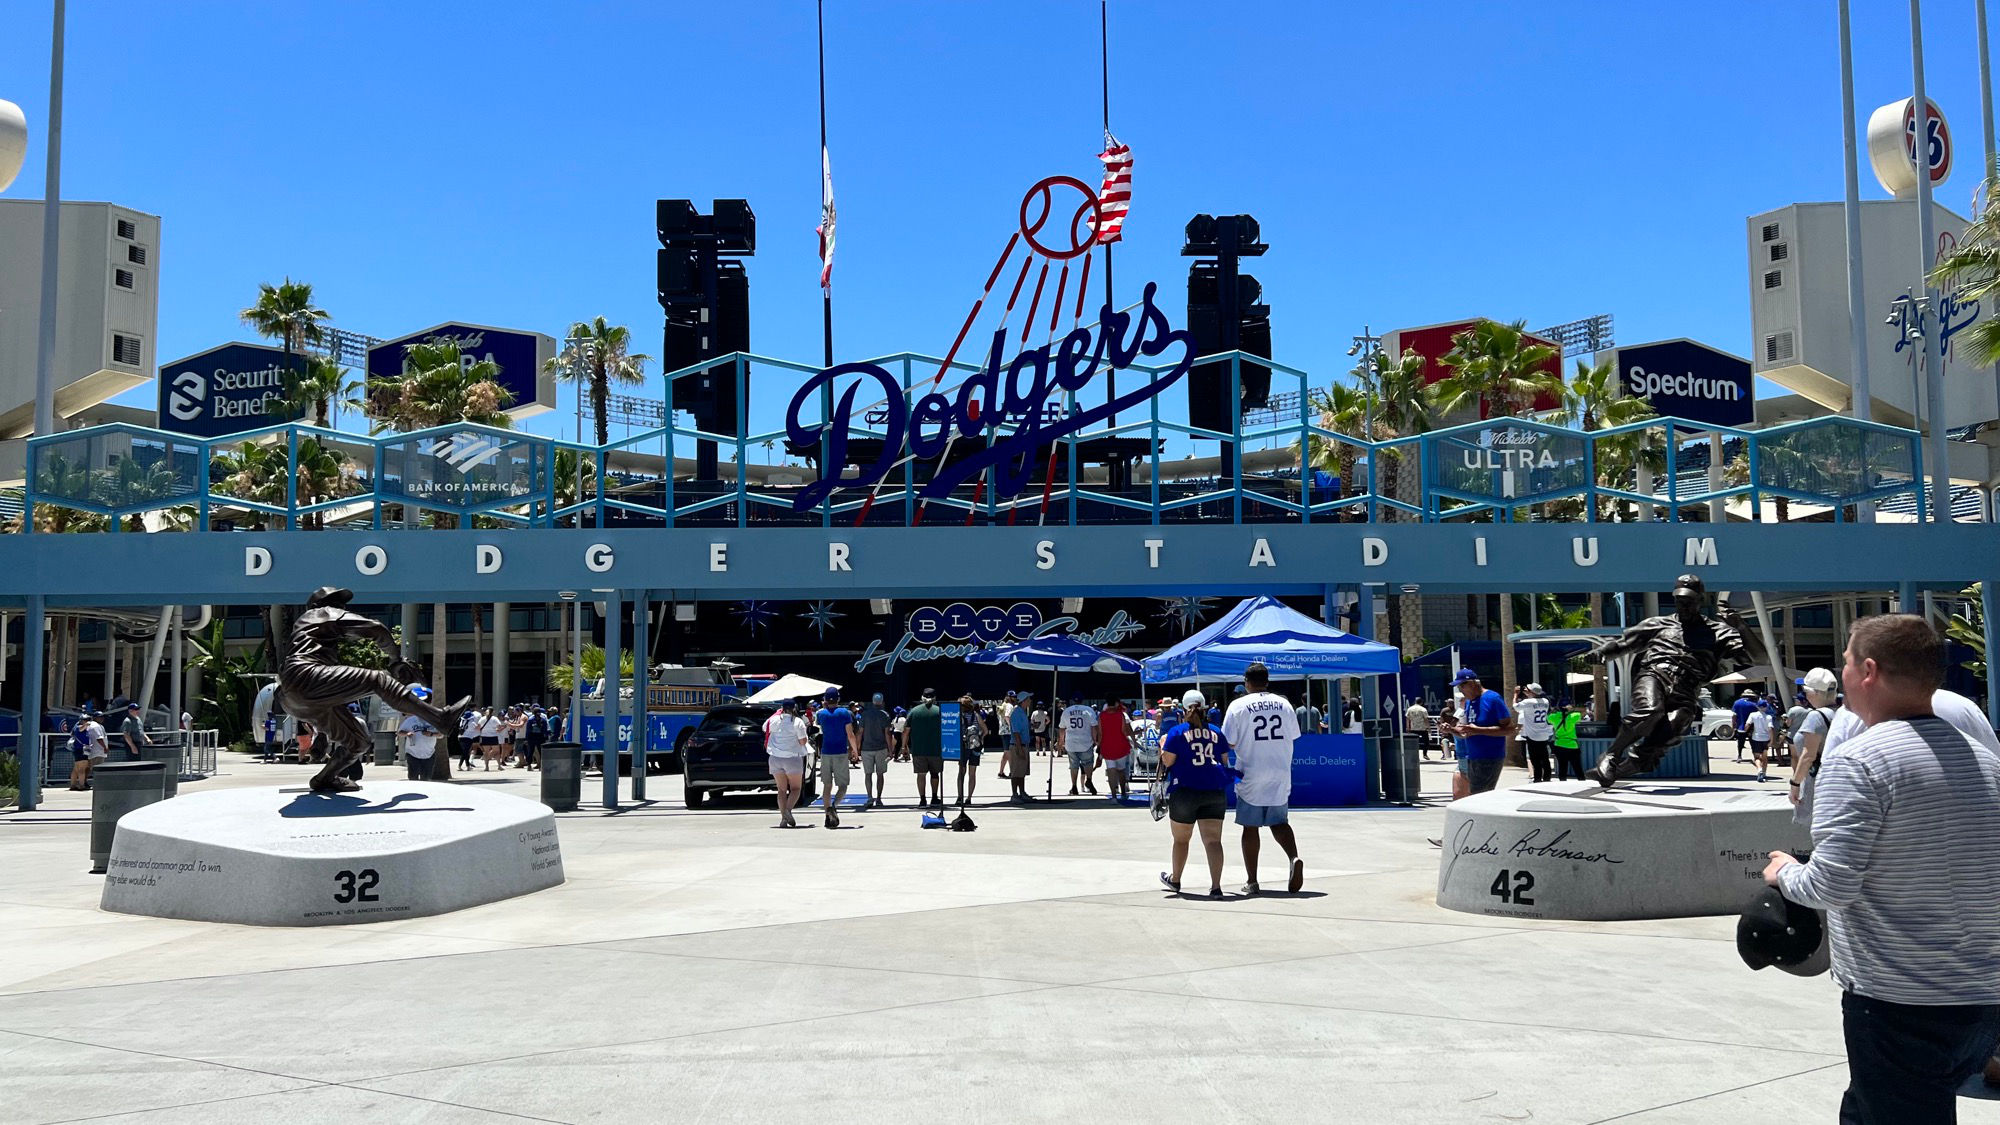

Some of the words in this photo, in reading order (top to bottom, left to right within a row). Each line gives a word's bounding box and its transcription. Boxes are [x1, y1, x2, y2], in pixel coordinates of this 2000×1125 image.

[1629, 366, 1739, 401] Spectrum
[786, 281, 1198, 512] Dodgers
[1475, 431, 1537, 446] Michelob
[1463, 449, 1553, 470] ULTRA
[408, 483, 441, 492] BANK
[444, 483, 460, 492] OF
[462, 483, 517, 492] AMERICA
[245, 543, 852, 576] DODGER
[1035, 537, 1720, 570] STADIUM
[919, 614, 1033, 632] BLUE
[854, 632, 978, 674] Heaven
[1246, 700, 1283, 714] KERSHAW
[1422, 685, 1441, 712] LA
[1069, 717, 1084, 729] 50
[1253, 714, 1284, 741] 22
[1534, 710, 1547, 724] 22
[587, 724, 597, 742] LA
[1183, 728, 1219, 744] WOOD
[1191, 743, 1218, 766] 34
[1292, 755, 1317, 765] onda
[1319, 755, 1357, 766] Dealers
[1443, 819, 1499, 892] Jackie
[1507, 828, 1625, 864] Robinson
[334, 869, 379, 904] 32
[1490, 869, 1535, 906] 42
